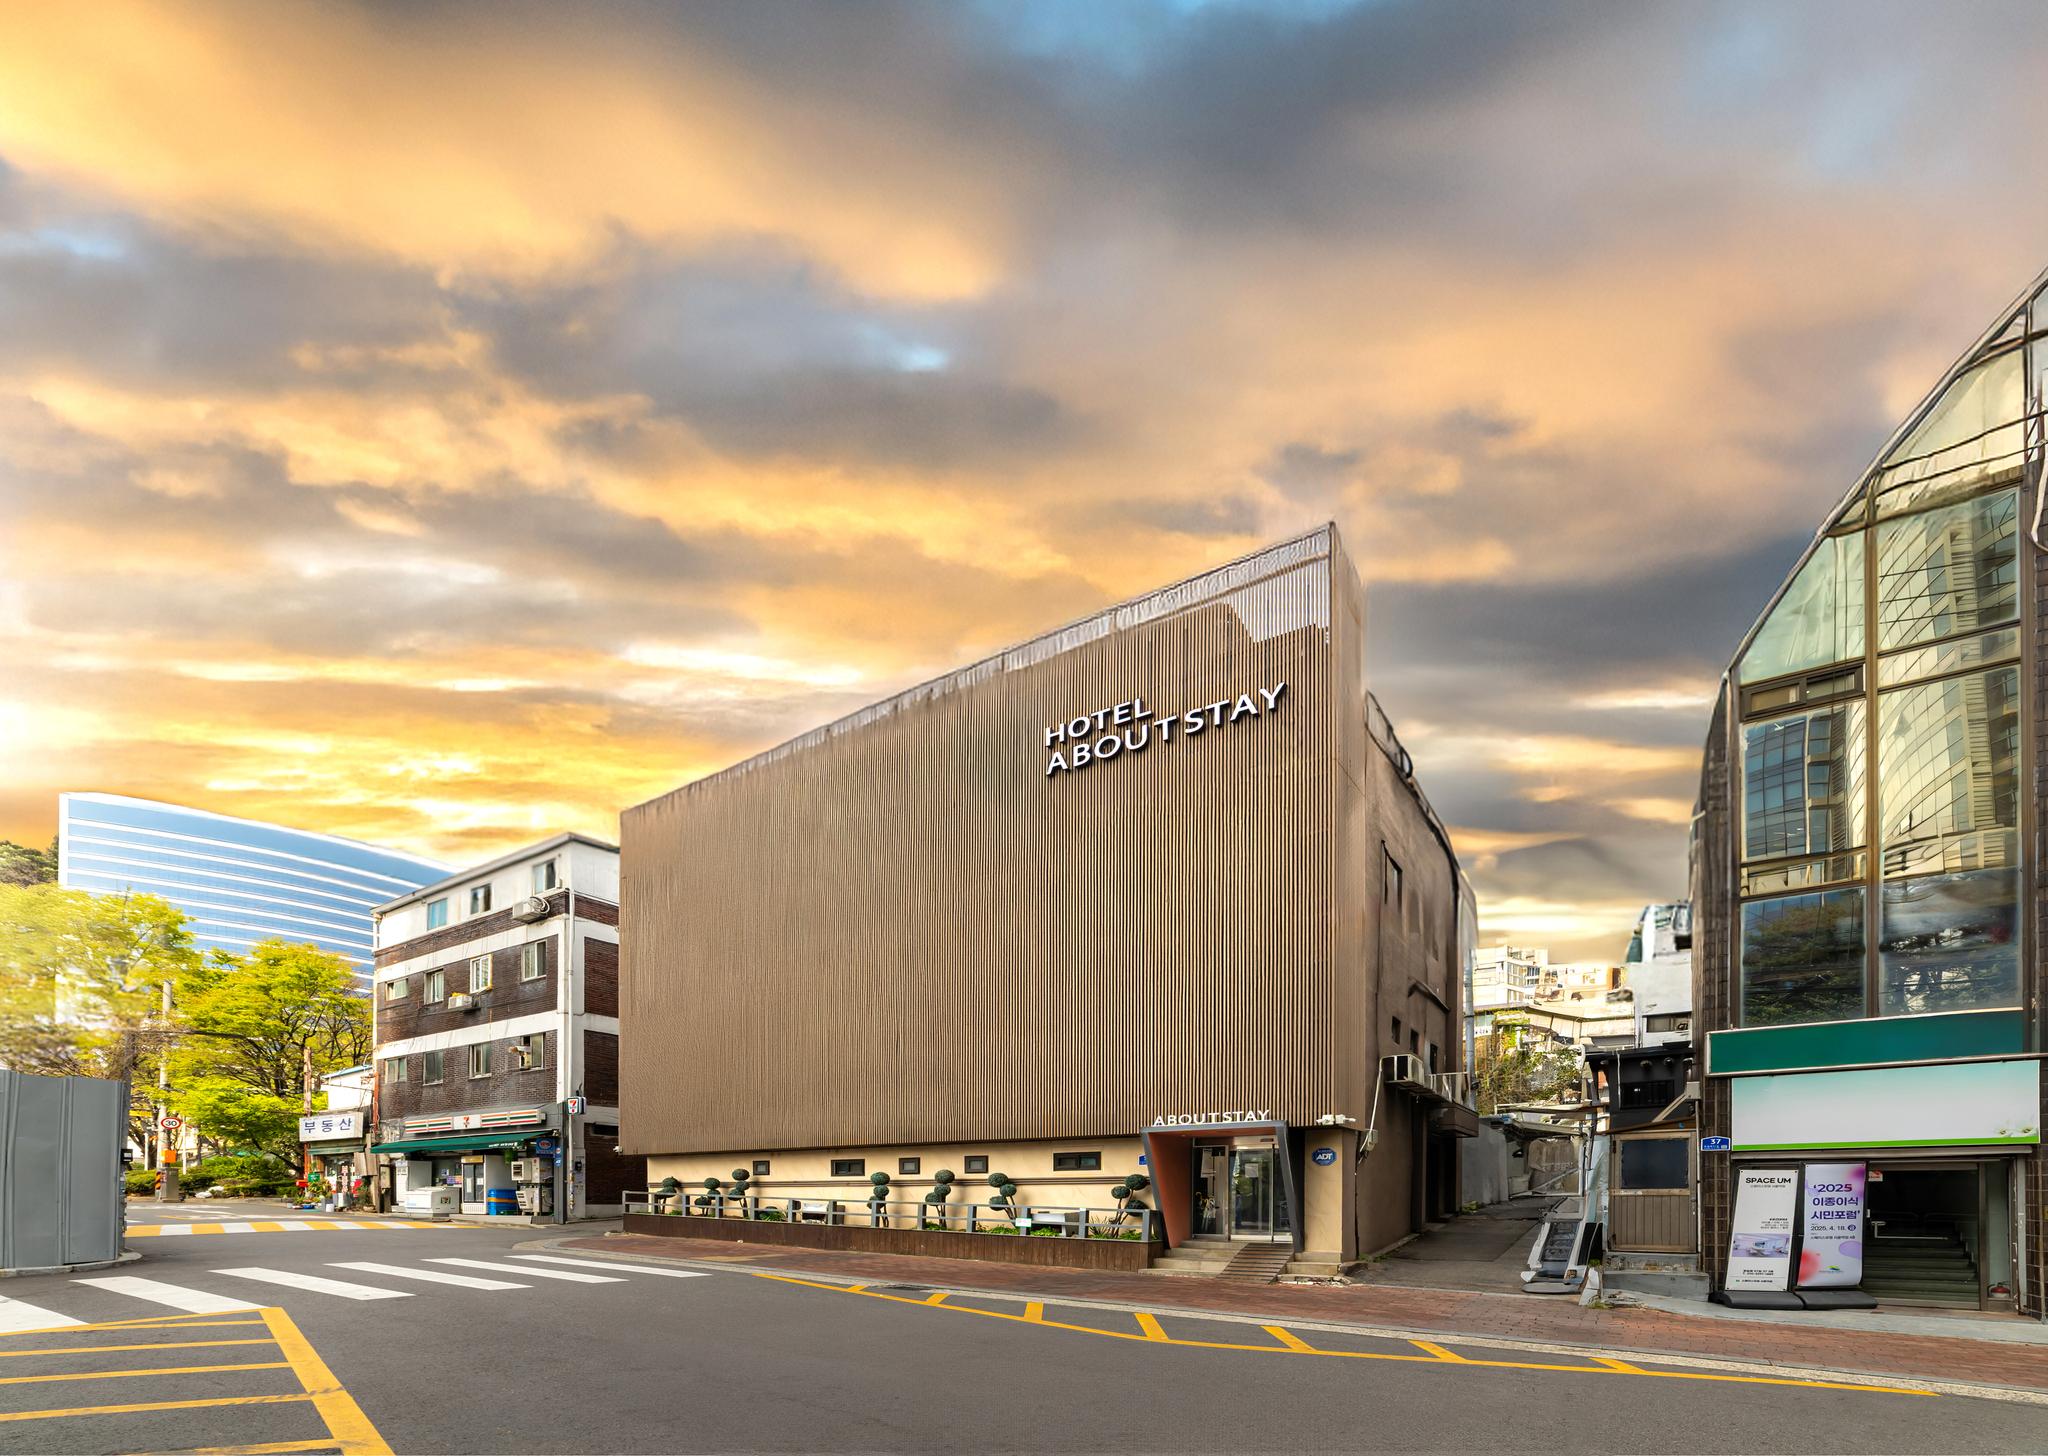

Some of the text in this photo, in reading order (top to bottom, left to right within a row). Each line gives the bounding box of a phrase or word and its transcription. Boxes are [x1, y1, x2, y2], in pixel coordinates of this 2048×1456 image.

[1045, 698, 1152, 747] HOTEL
[304, 1117, 352, 1133] 부동산
[1316, 1153, 1333, 1161] ADT
[1812, 1197, 1859, 1207] 이종이식
